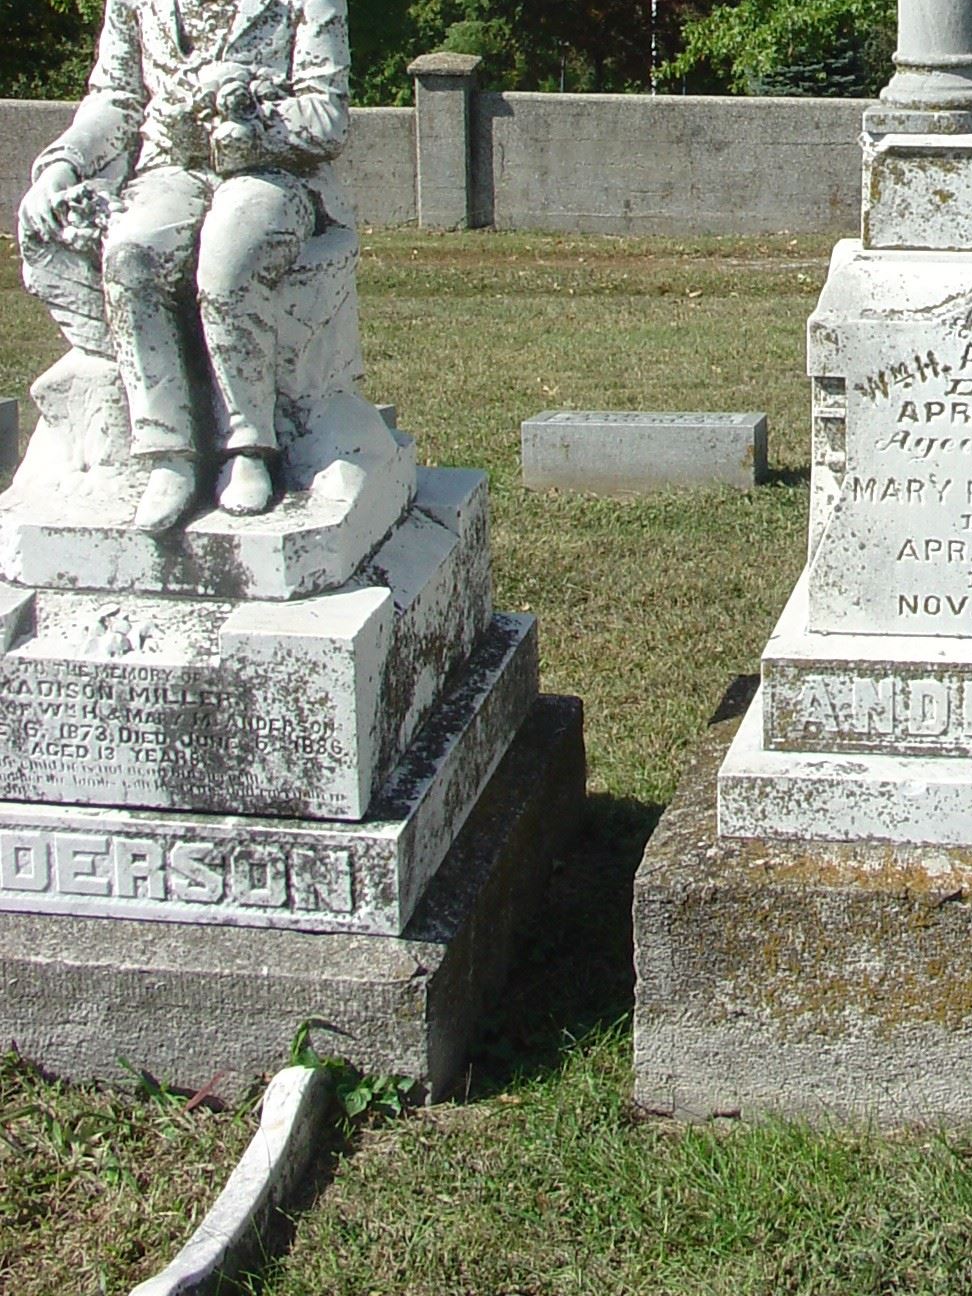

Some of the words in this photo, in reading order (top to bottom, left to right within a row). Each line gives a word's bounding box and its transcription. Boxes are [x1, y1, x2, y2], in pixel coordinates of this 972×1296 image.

[852, 477, 952, 504] MARY
[94, 663, 173, 682] MEMORY
[129, 686, 233, 707] MILLER
[118, 726, 168, 746] DIED
[31, 742, 89, 760] AGED
[98, 746, 116, 762] 13
